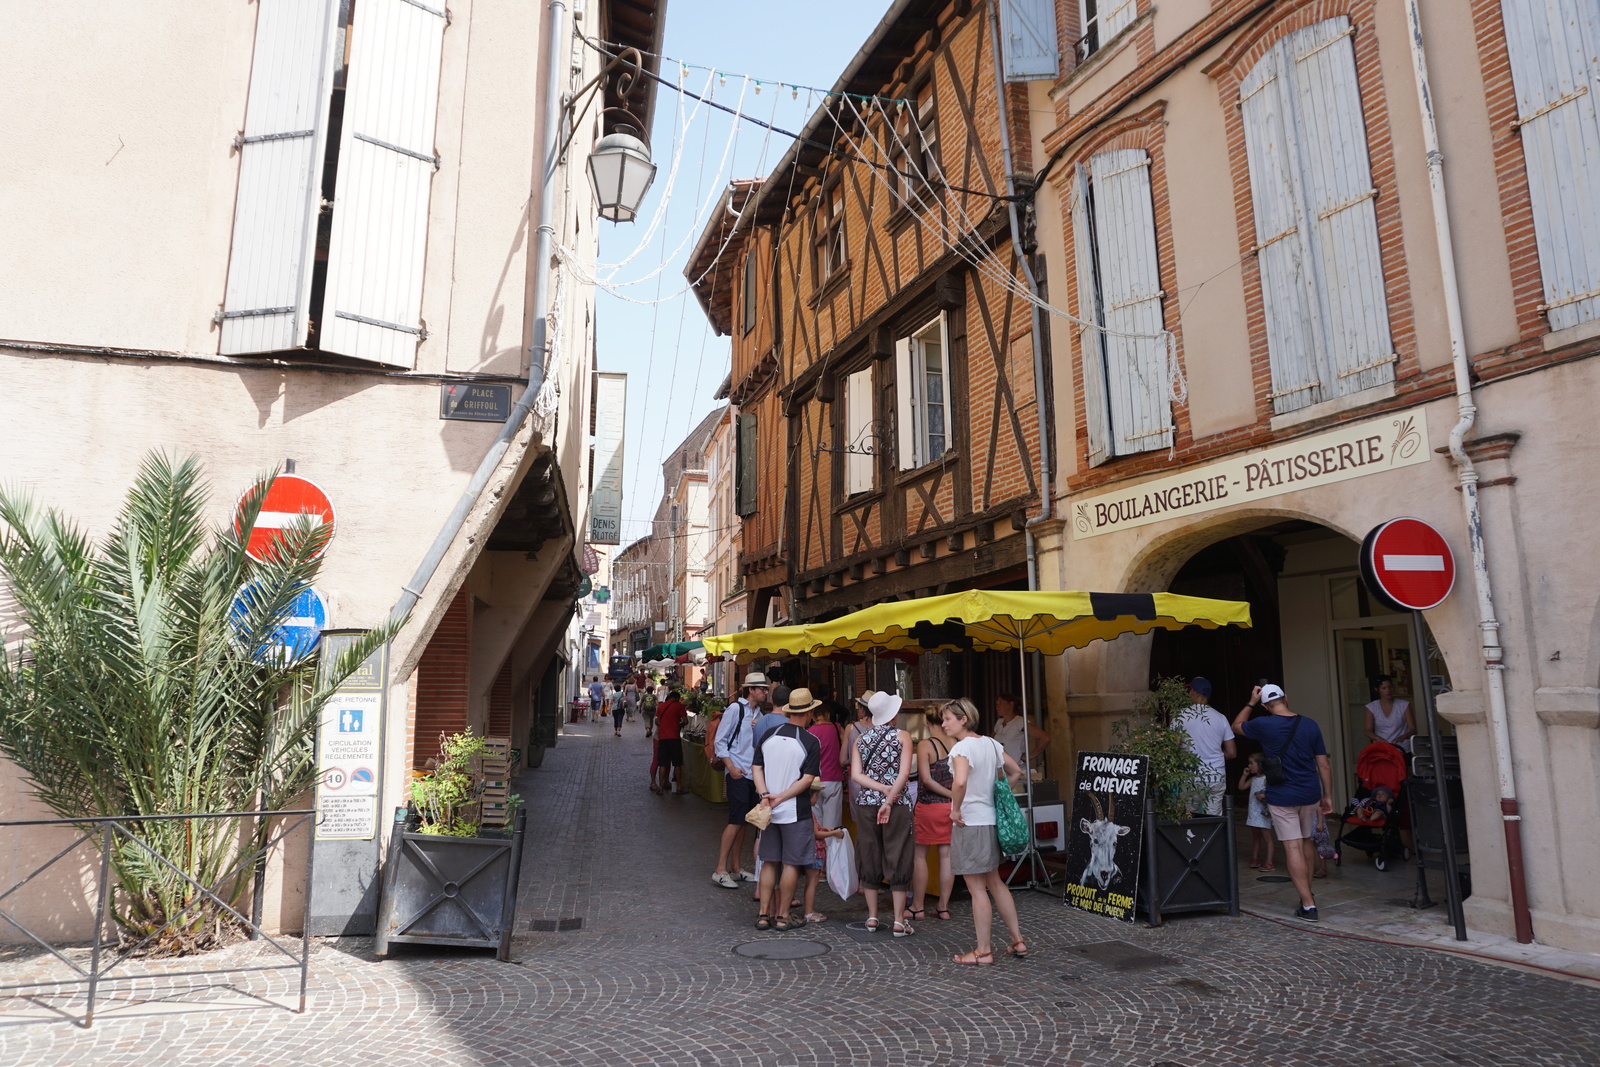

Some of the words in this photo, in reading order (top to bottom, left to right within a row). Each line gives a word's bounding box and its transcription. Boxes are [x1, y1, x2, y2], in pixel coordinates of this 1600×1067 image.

[472, 388, 494, 398] PLACE
[450, 400, 458, 408] du
[464, 400, 498, 411] GRIFFOUL
[1095, 474, 1229, 527] BOULANGERIE
[1244, 435, 1385, 492] PÂTISSERIE
[592, 517, 616, 530] DENIS
[1082, 756, 1140, 776] FROMAGE
[328, 774, 342, 783] 10
[1079, 780, 1092, 791] de
[1093, 776, 1140, 795] CHEVRE
[1066, 883, 1098, 900] PRODUIT
[1107, 892, 1134, 909] FERME
[1071, 896, 1079, 906] LE
[1080, 898, 1093, 910] MAS
[1093, 901, 1104, 913] DEL
